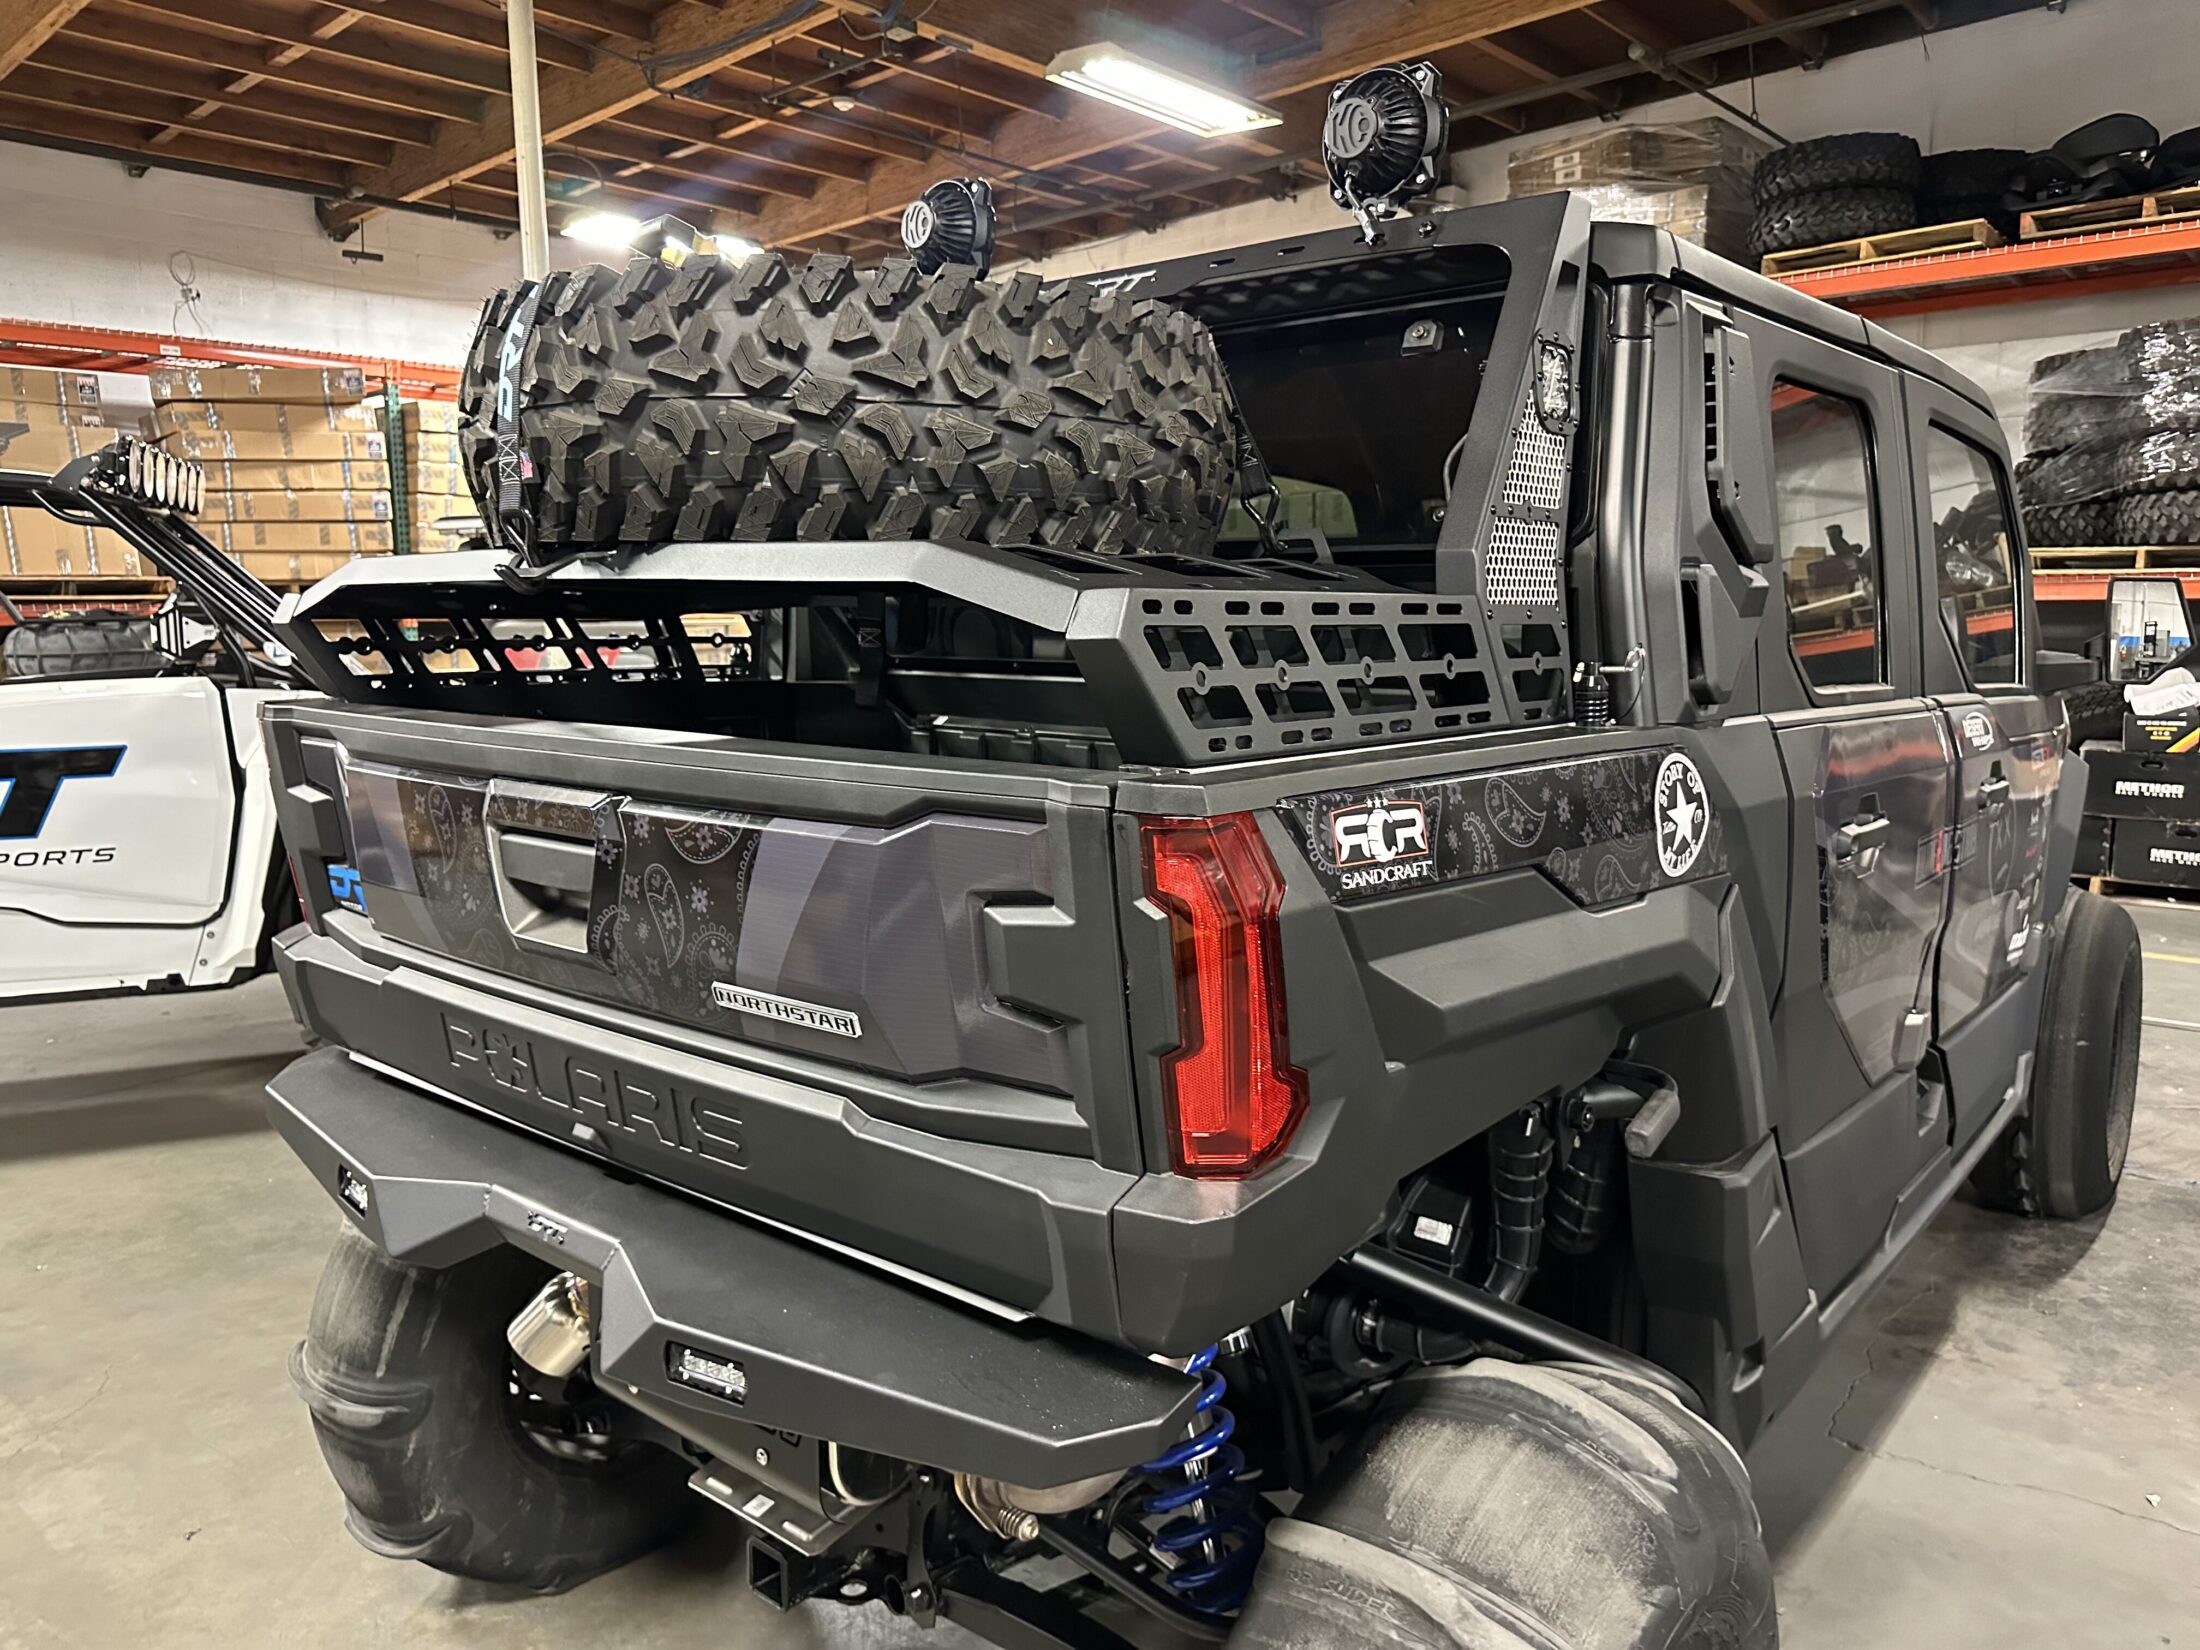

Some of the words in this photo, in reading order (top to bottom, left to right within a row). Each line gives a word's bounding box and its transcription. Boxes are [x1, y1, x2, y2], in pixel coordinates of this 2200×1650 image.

[1342, 860, 1433, 890] SANDCRAFT
[717, 988, 851, 1034] NORTHSTAR
[440, 1012, 748, 1170] POLARIS
